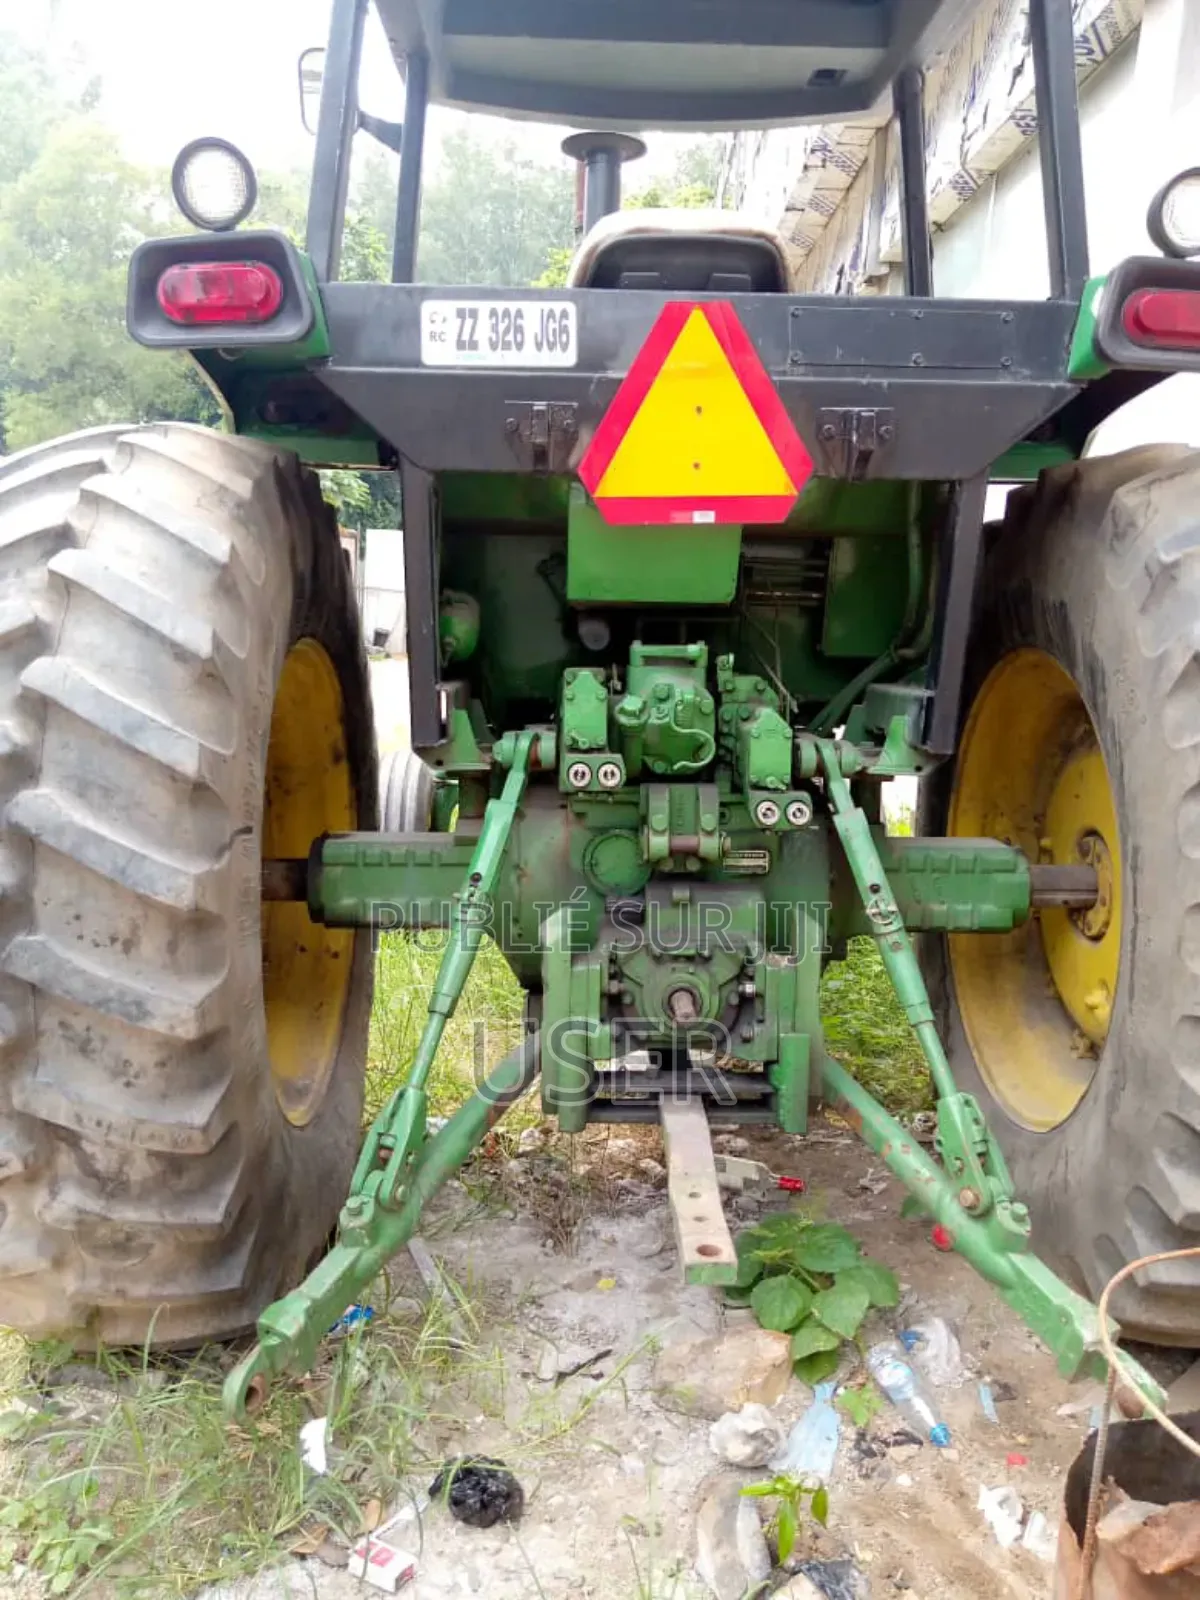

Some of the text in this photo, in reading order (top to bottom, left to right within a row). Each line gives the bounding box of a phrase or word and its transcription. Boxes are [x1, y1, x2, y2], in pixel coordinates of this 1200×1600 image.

[455, 307, 570, 353] ZZ 326 JG6
